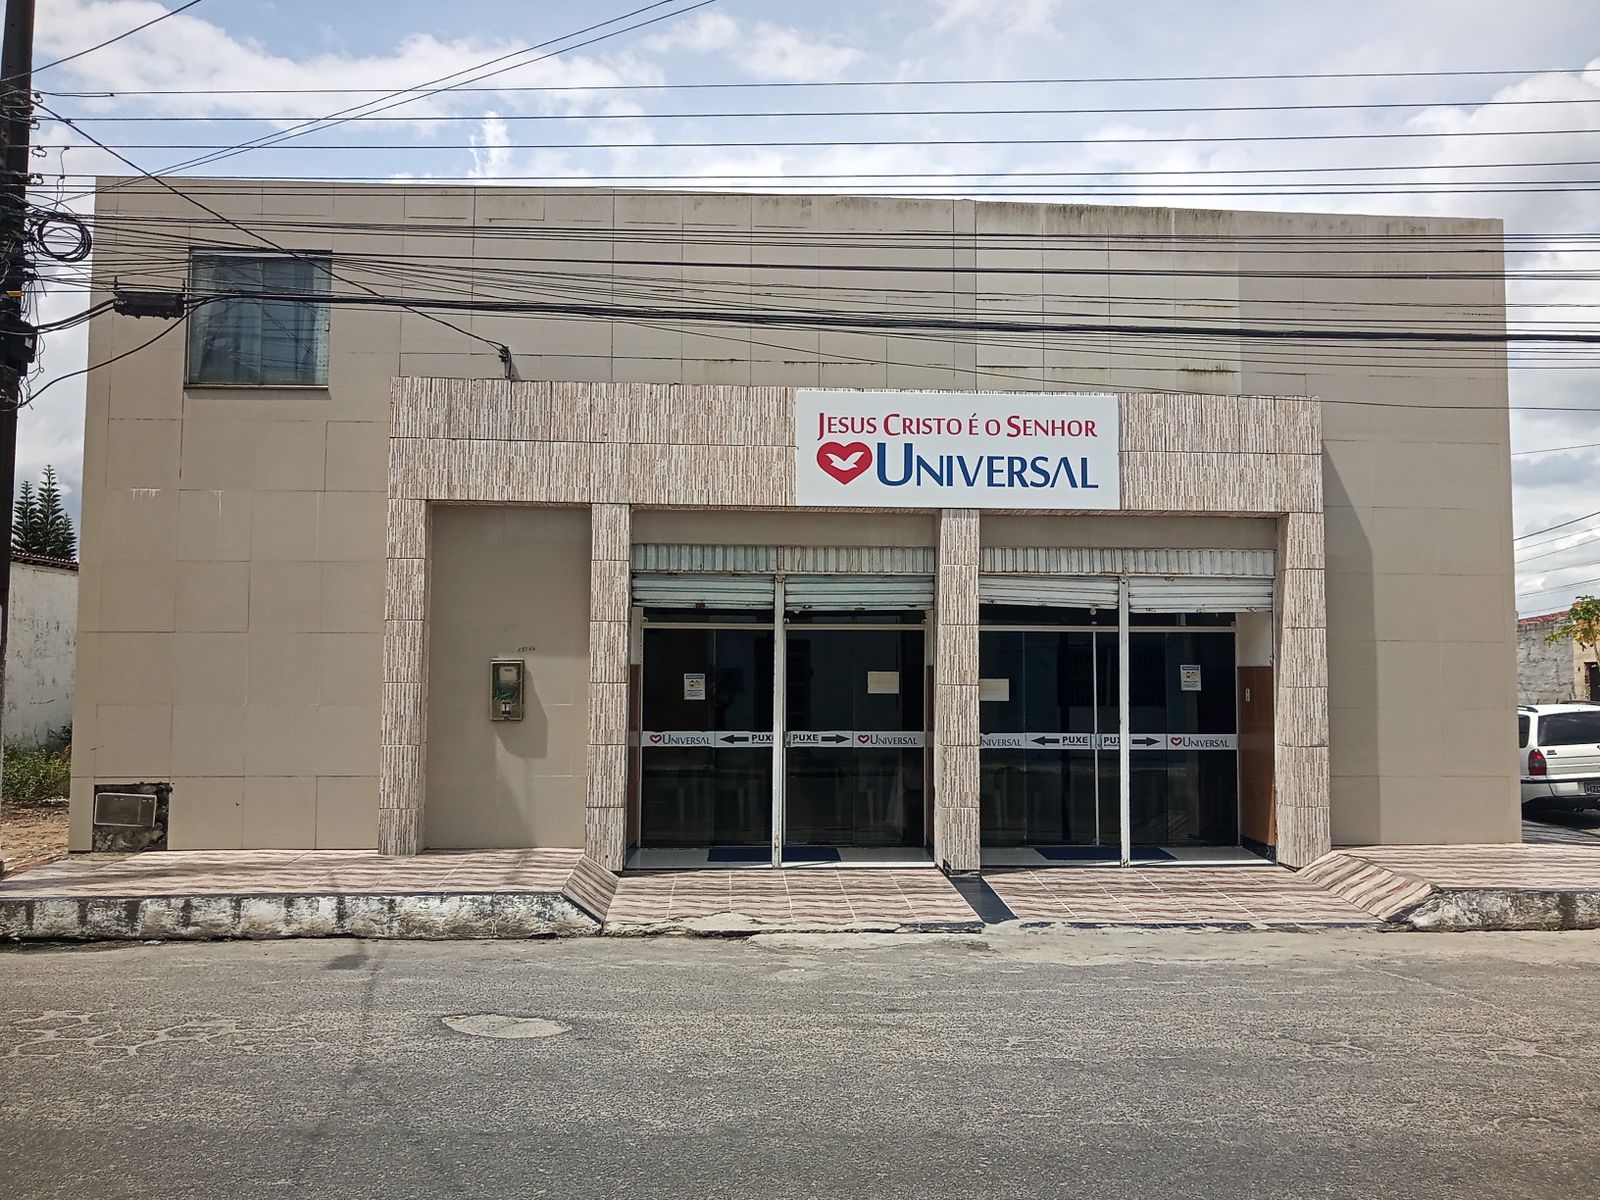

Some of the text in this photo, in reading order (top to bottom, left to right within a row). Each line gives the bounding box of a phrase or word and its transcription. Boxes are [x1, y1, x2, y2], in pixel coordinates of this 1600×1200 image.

[817, 412, 1098, 441] JESUS CRISTO É O SENHOR
[876, 442, 1099, 488] UNIVERSAL
[662, 734, 711, 745] UNIVERSAL
[792, 734, 819, 742] PUXE
[870, 734, 918, 745] UNIVERSAL
[1062, 736, 1088, 744] PUXE
[1183, 736, 1229, 748] UNIVERSAL
